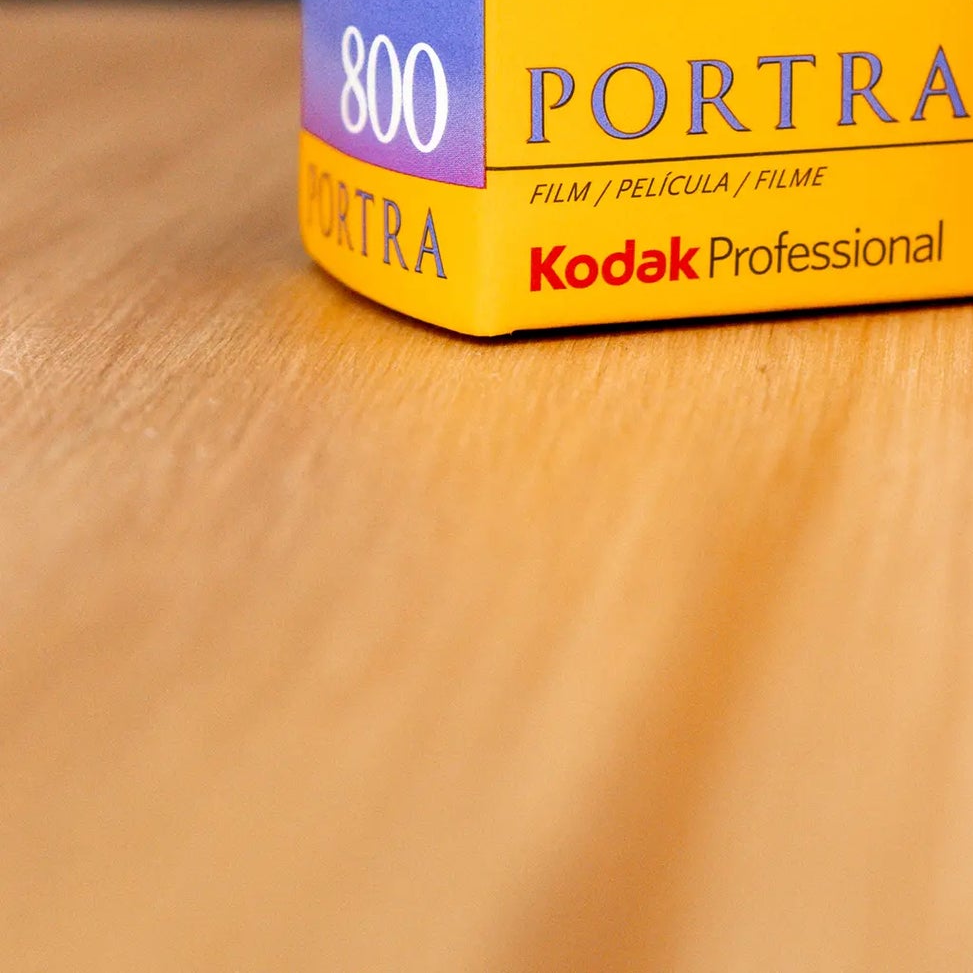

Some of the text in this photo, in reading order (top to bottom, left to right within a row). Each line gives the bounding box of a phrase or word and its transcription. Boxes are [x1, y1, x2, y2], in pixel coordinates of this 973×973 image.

[341, 25, 449, 153] 800
[526, 45, 971, 145] PORTRA
[304, 163, 448, 279] PORTRA
[530, 181, 592, 204] FILM
[616, 171, 729, 199] PELÍCULA
[755, 166, 828, 190] FILME
[530, 220, 944, 292] Kodak Professional
